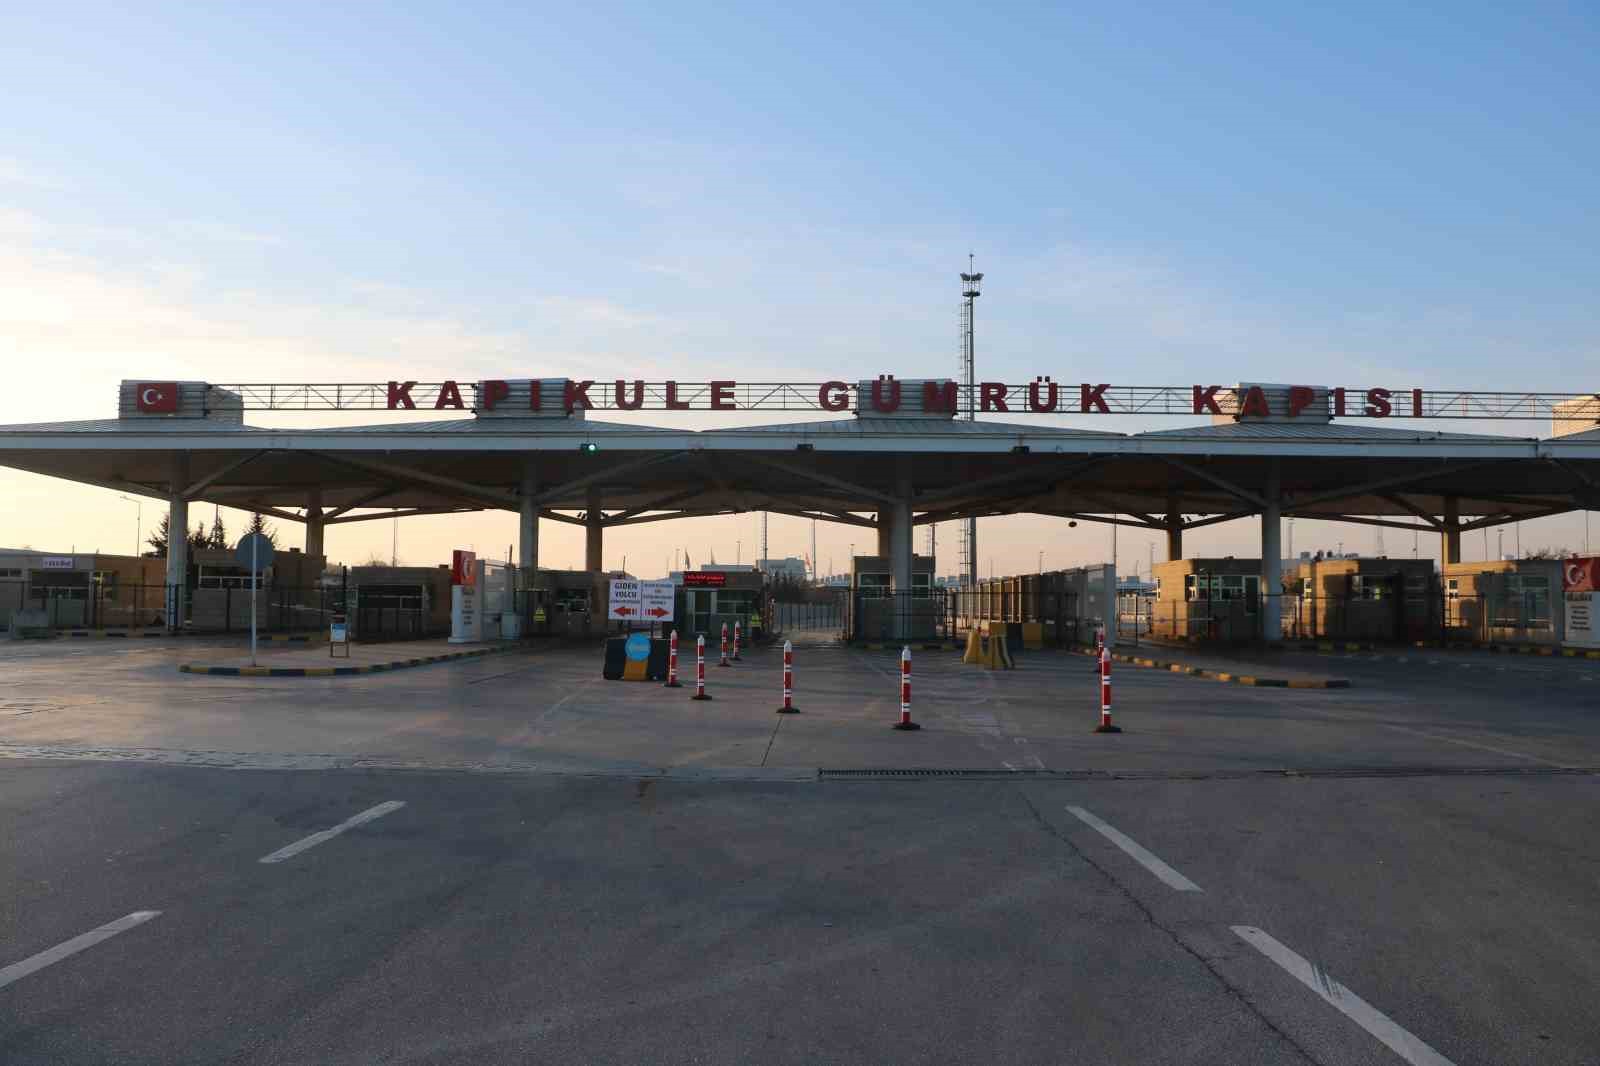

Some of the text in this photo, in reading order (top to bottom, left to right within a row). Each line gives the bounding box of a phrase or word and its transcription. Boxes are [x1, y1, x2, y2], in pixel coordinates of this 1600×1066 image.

[387, 374, 1423, 417] KAPIKULE GÜMRÜK KAPISI
